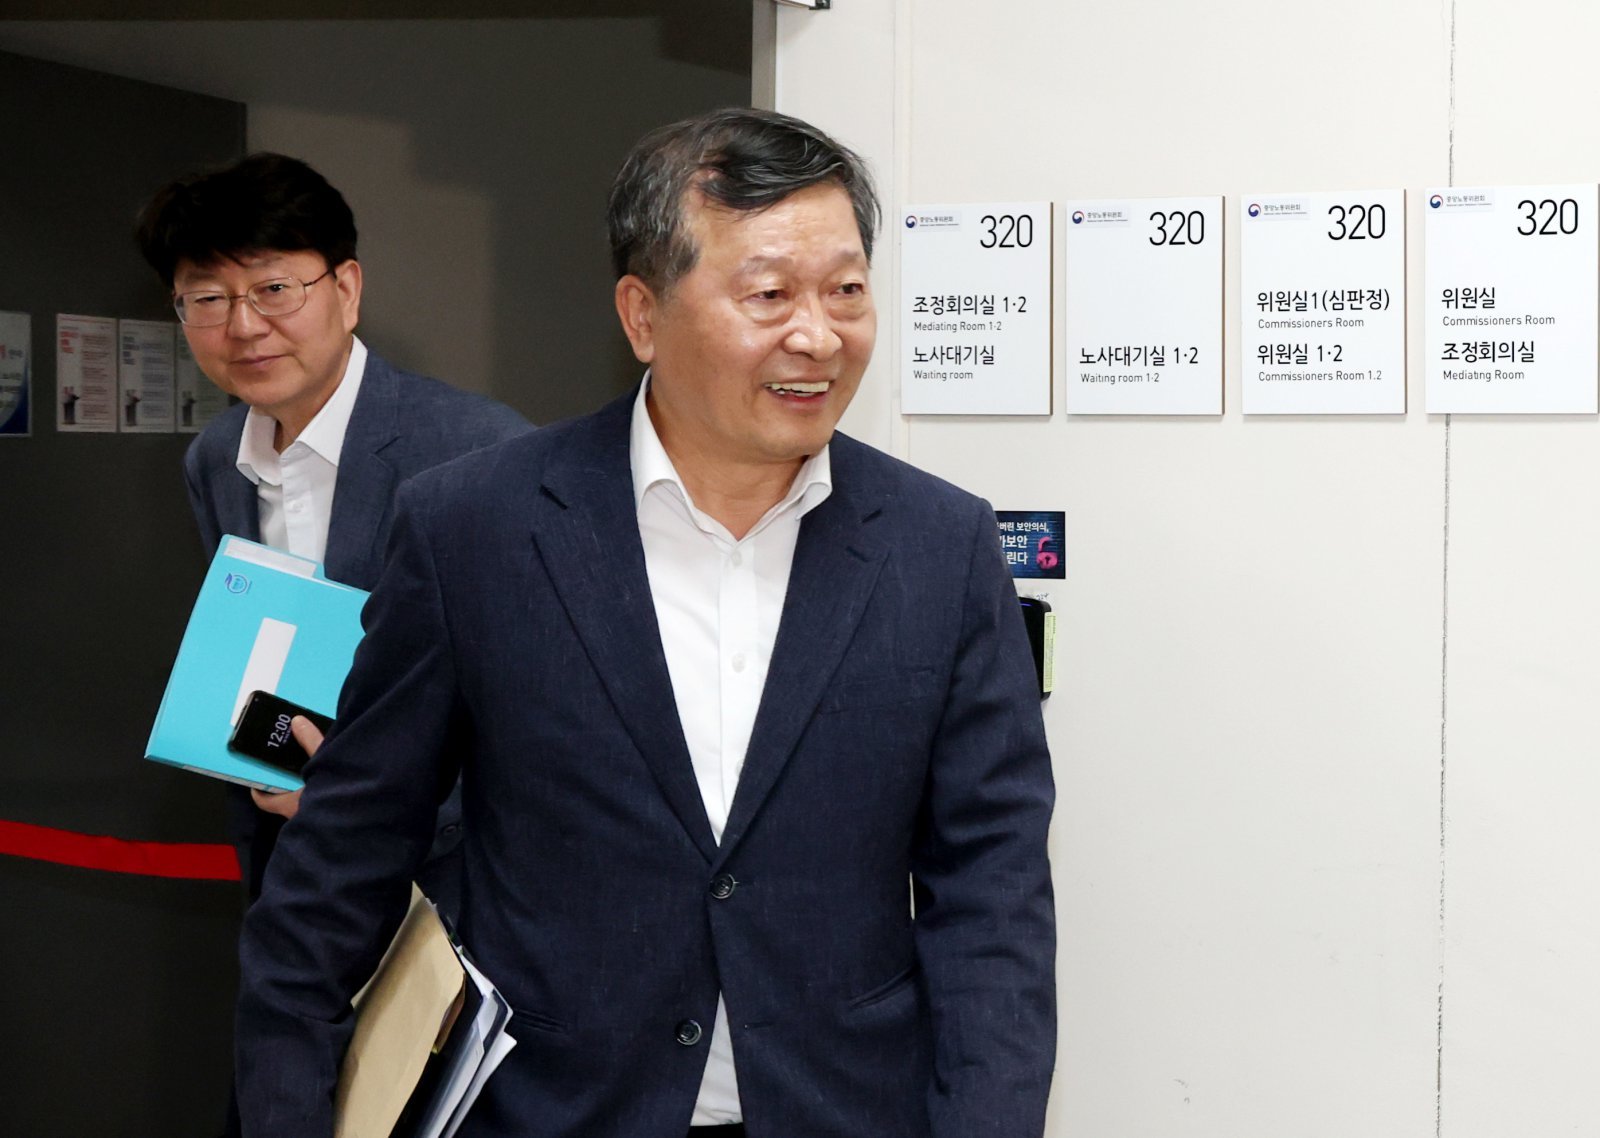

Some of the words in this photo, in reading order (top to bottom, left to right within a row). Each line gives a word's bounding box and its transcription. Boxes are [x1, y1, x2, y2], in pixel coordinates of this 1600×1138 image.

[1328, 204, 1386, 240] 320
[1517, 198, 1578, 236] 320
[980, 215, 1033, 248] 320
[1149, 210, 1204, 246] 320
[912, 294, 995, 315] 조정회의실
[1256, 289, 1390, 312] 위원실1(심판정)
[1441, 287, 1496, 309] 위원실
[914, 321, 957, 332] Mediating
[960, 321, 985, 331] Room
[1258, 318, 1333, 329] Commissioners
[1336, 317, 1364, 328] Room
[1442, 316, 1522, 327] Commissioners
[1525, 314, 1555, 325] Room
[912, 345, 995, 366] 노사대기실
[1080, 346, 1165, 367] 노사대기실
[1256, 343, 1308, 365] 위원실
[1441, 341, 1535, 363] 조정회의실
[914, 370, 947, 382] Waiting
[950, 372, 973, 380] room
[1080, 373, 1115, 385] Waiting
[1118, 375, 1142, 383] room
[1259, 371, 1333, 382] Commissioners
[1336, 371, 1364, 381] Room
[1443, 370, 1491, 382] Mediating
[1494, 369, 1524, 380] Room
[997, 522, 1014, 532] 버린
[1016, 522, 1049, 533] 보안의식,
[1003, 551, 1028, 565] 린다
[267, 714, 291, 748] 12:00
